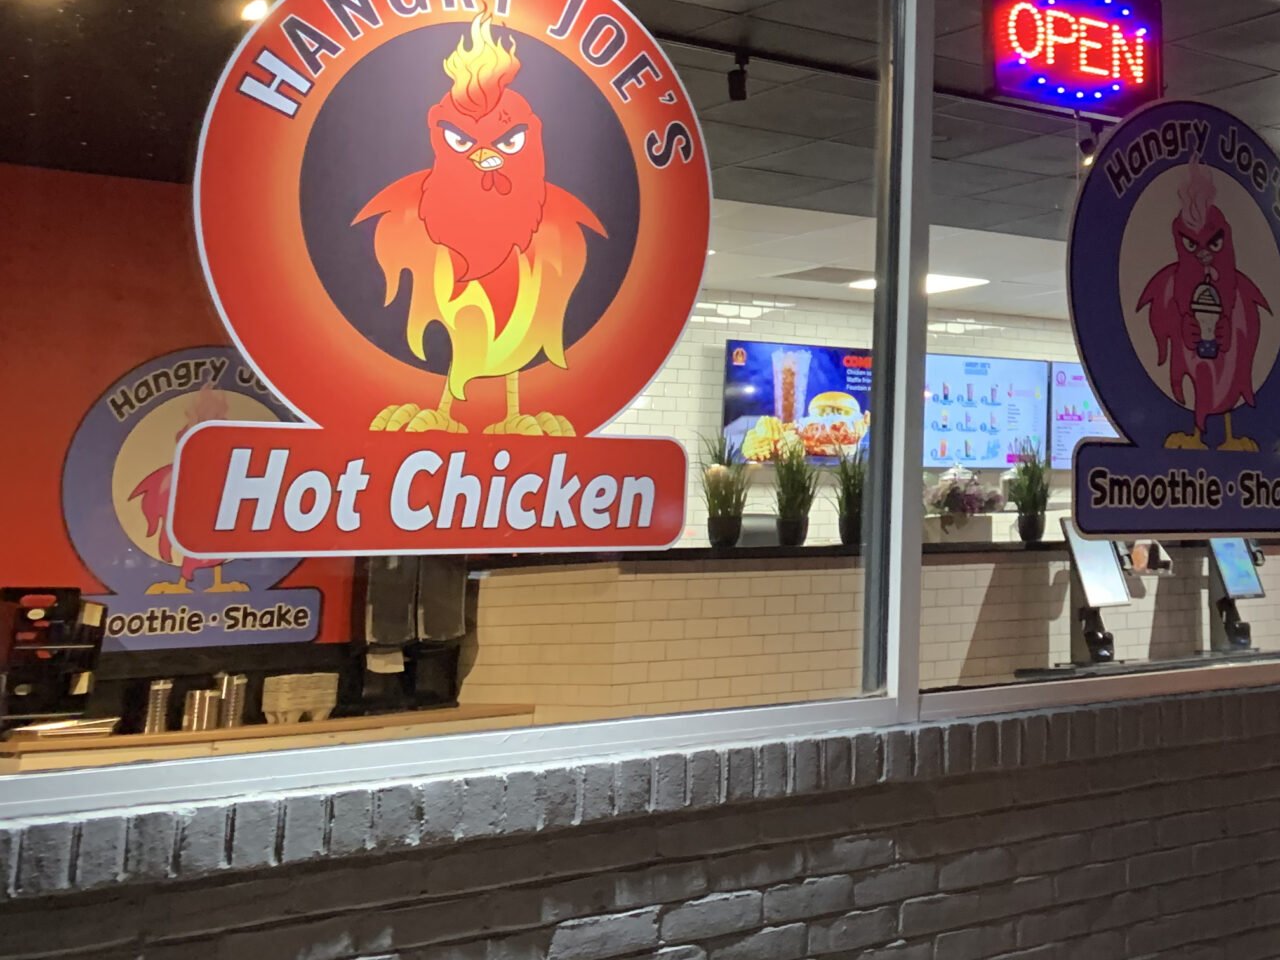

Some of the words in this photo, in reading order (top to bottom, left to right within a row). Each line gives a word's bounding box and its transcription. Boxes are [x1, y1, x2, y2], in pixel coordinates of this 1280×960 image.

[1008, 2, 1145, 84] OPEN
[1104, 119, 1211, 198] Hangry
[106, 357, 229, 422] Hangry
[214, 447, 371, 532] Hot
[389, 449, 656, 532] Chicken
[1088, 467, 1223, 510] Smoothie
[106, 605, 206, 638] oothie
[223, 602, 313, 633] Shake
